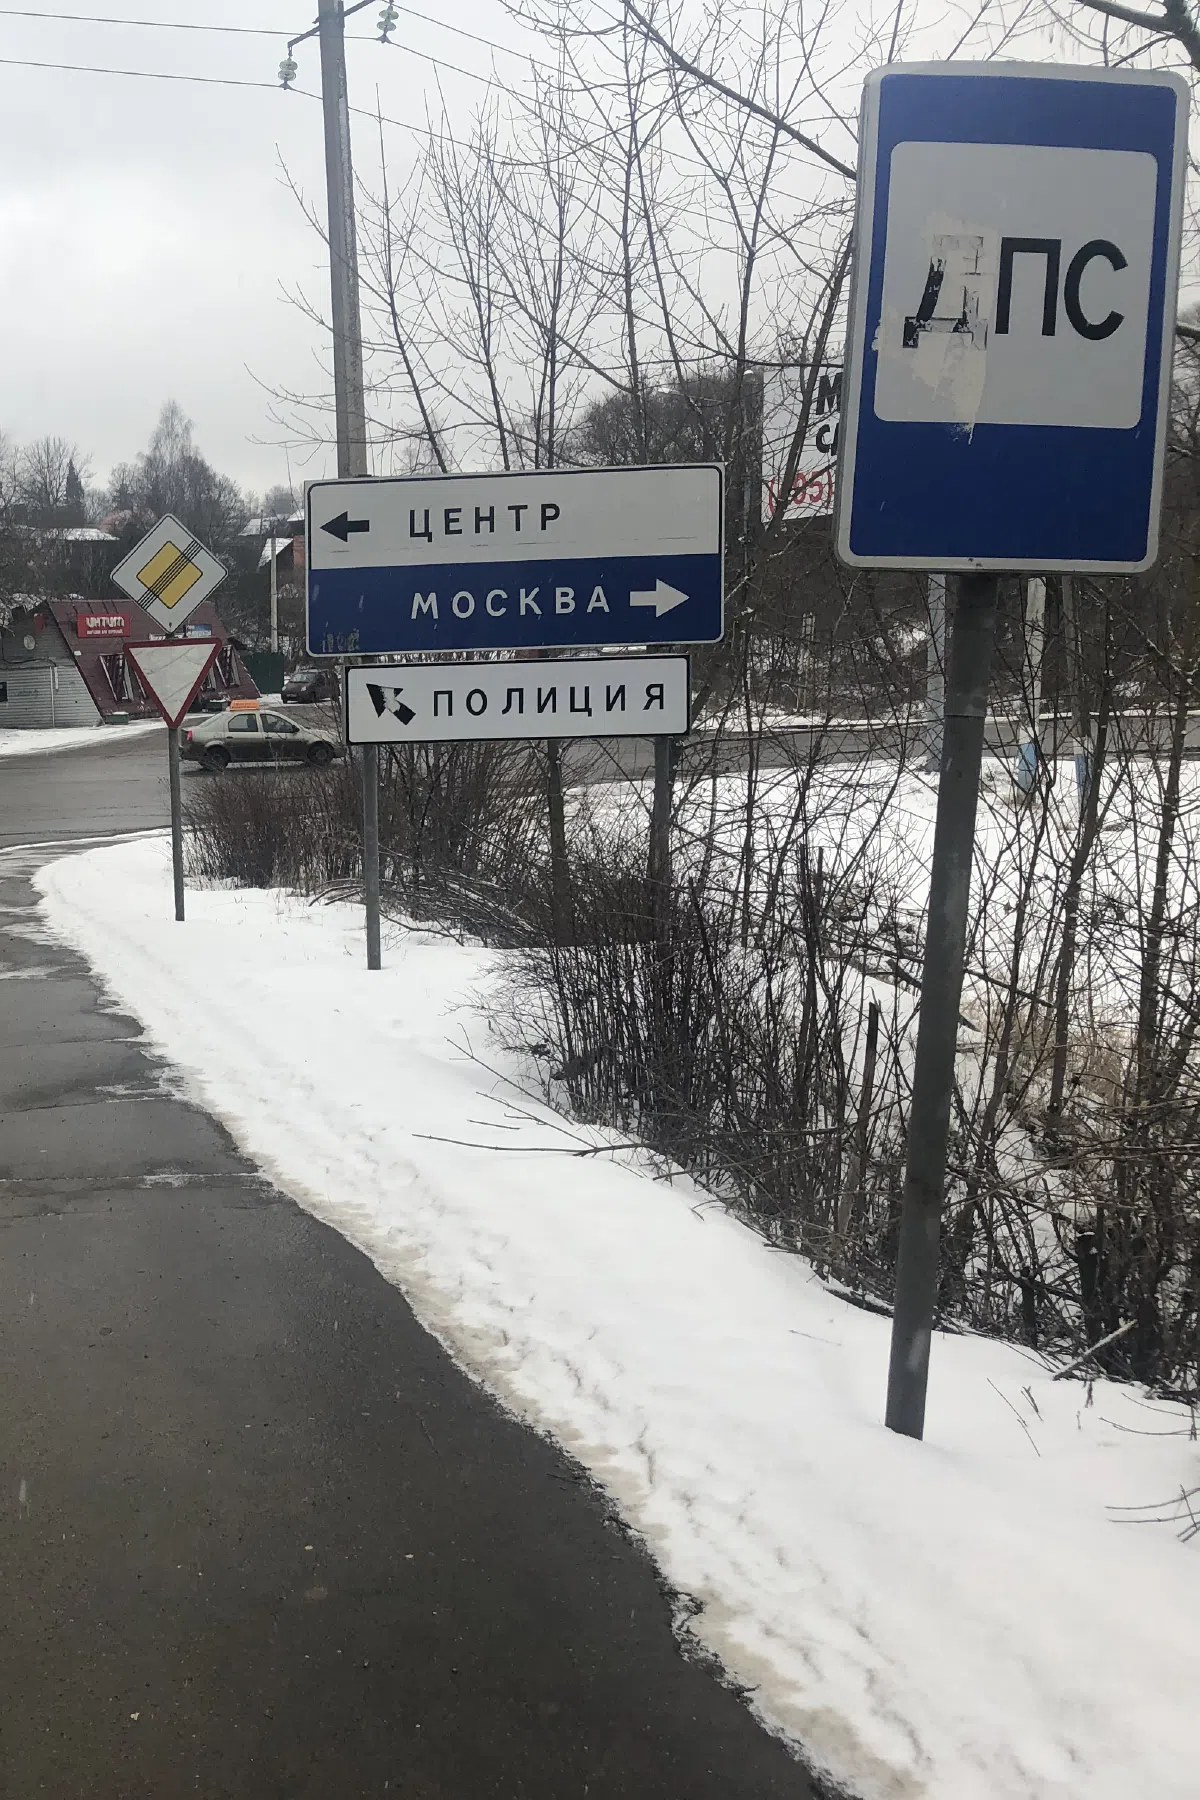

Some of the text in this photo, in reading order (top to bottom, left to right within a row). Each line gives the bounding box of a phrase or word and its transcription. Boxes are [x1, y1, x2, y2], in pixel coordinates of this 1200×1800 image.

[902, 236, 1130, 350] ДПС
[408, 502, 562, 544] ЦЕНТР
[410, 585, 611, 620] МОСКВА
[432, 682, 666, 718] ПОЛИЦИЯ
